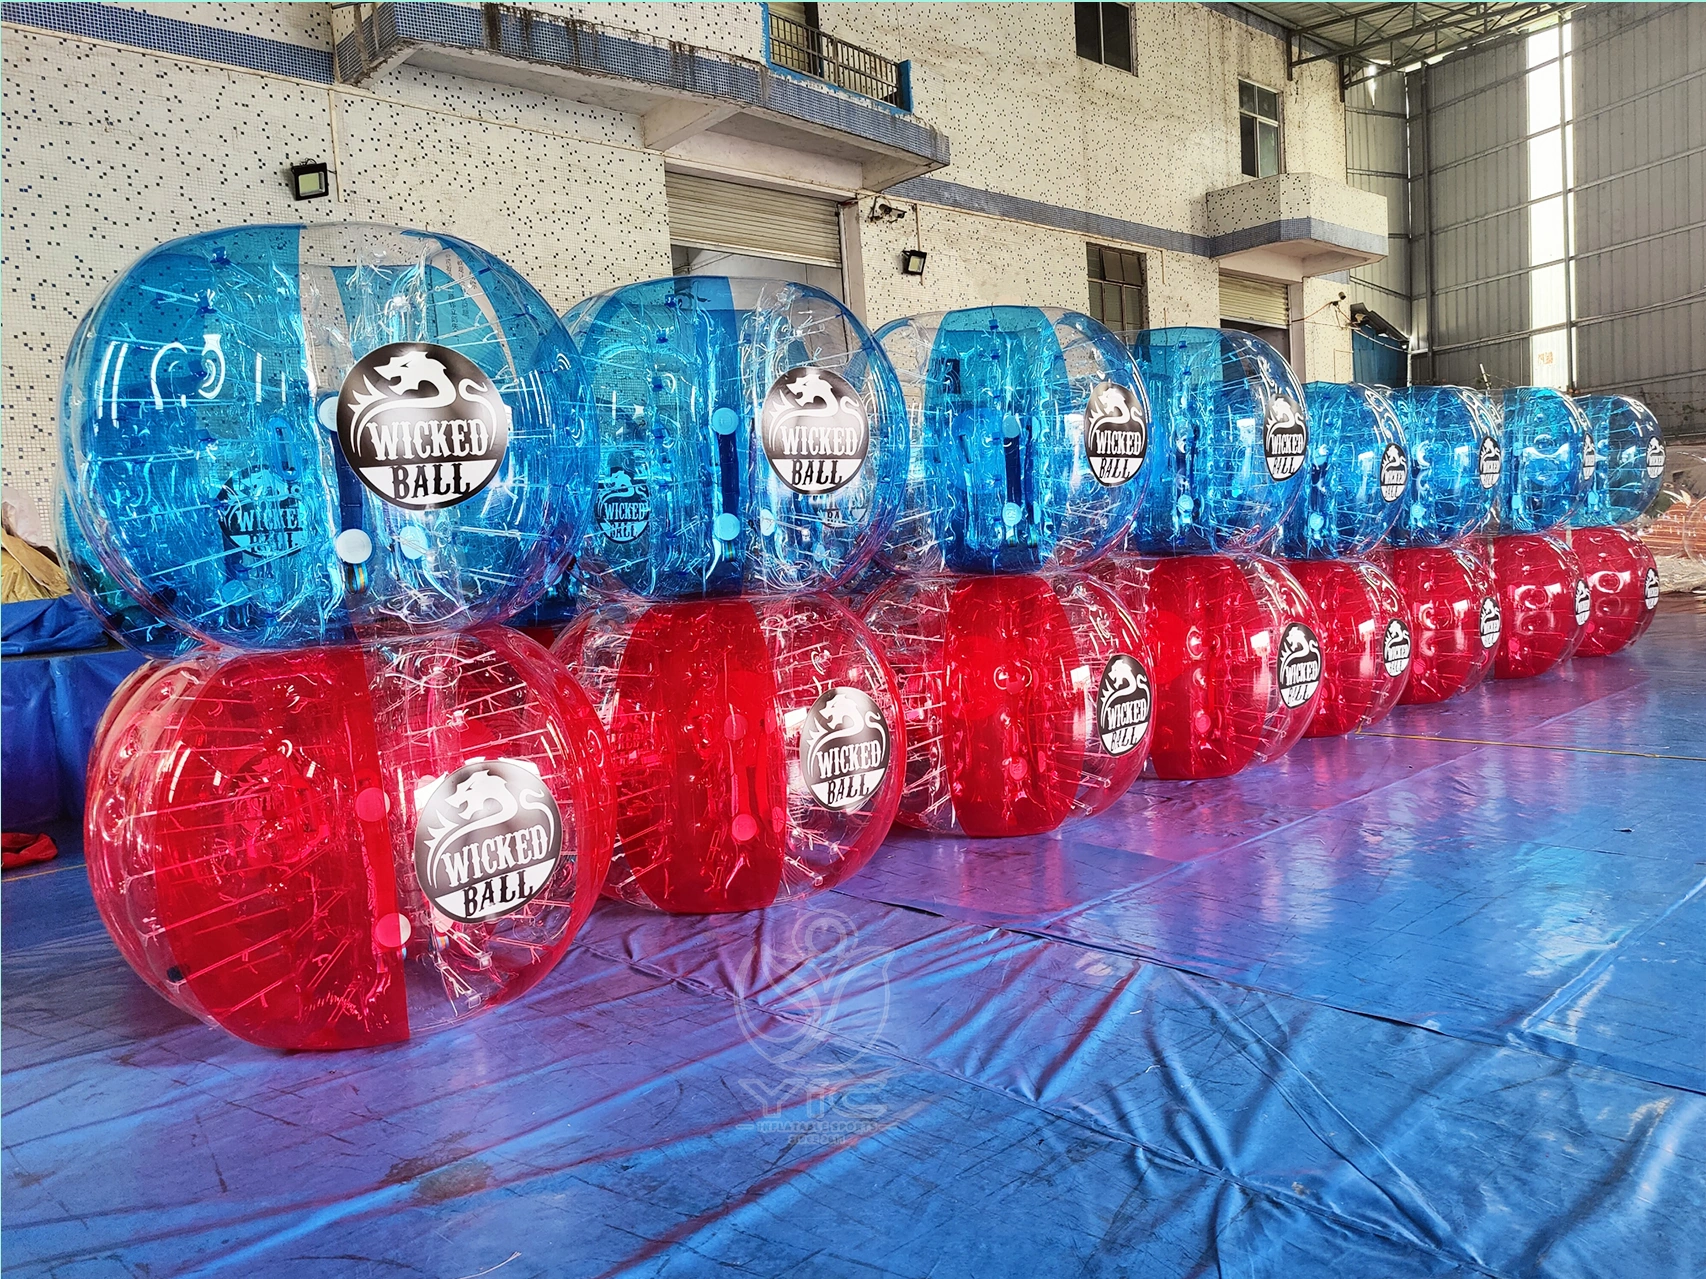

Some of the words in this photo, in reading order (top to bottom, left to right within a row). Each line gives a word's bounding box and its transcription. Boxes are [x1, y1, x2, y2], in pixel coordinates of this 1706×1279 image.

[369, 419, 489, 461] WICKED
[779, 425, 859, 456] WICKED
[1094, 428, 1142, 457] WICKED
[1271, 433, 1304, 455] WICKED
[390, 462, 472, 499] BALL
[791, 458, 844, 487] BALL
[1099, 458, 1131, 480] BALL
[604, 502, 645, 521] WICKED
[1285, 660, 1318, 686] WICKED
[1107, 697, 1147, 731] WICKED
[1110, 726, 1138, 752] BALL
[815, 738, 886, 780] WICKED
[826, 772, 871, 806] BALL
[441, 825, 549, 888] WICKED
[462, 871, 535, 919] BALL
